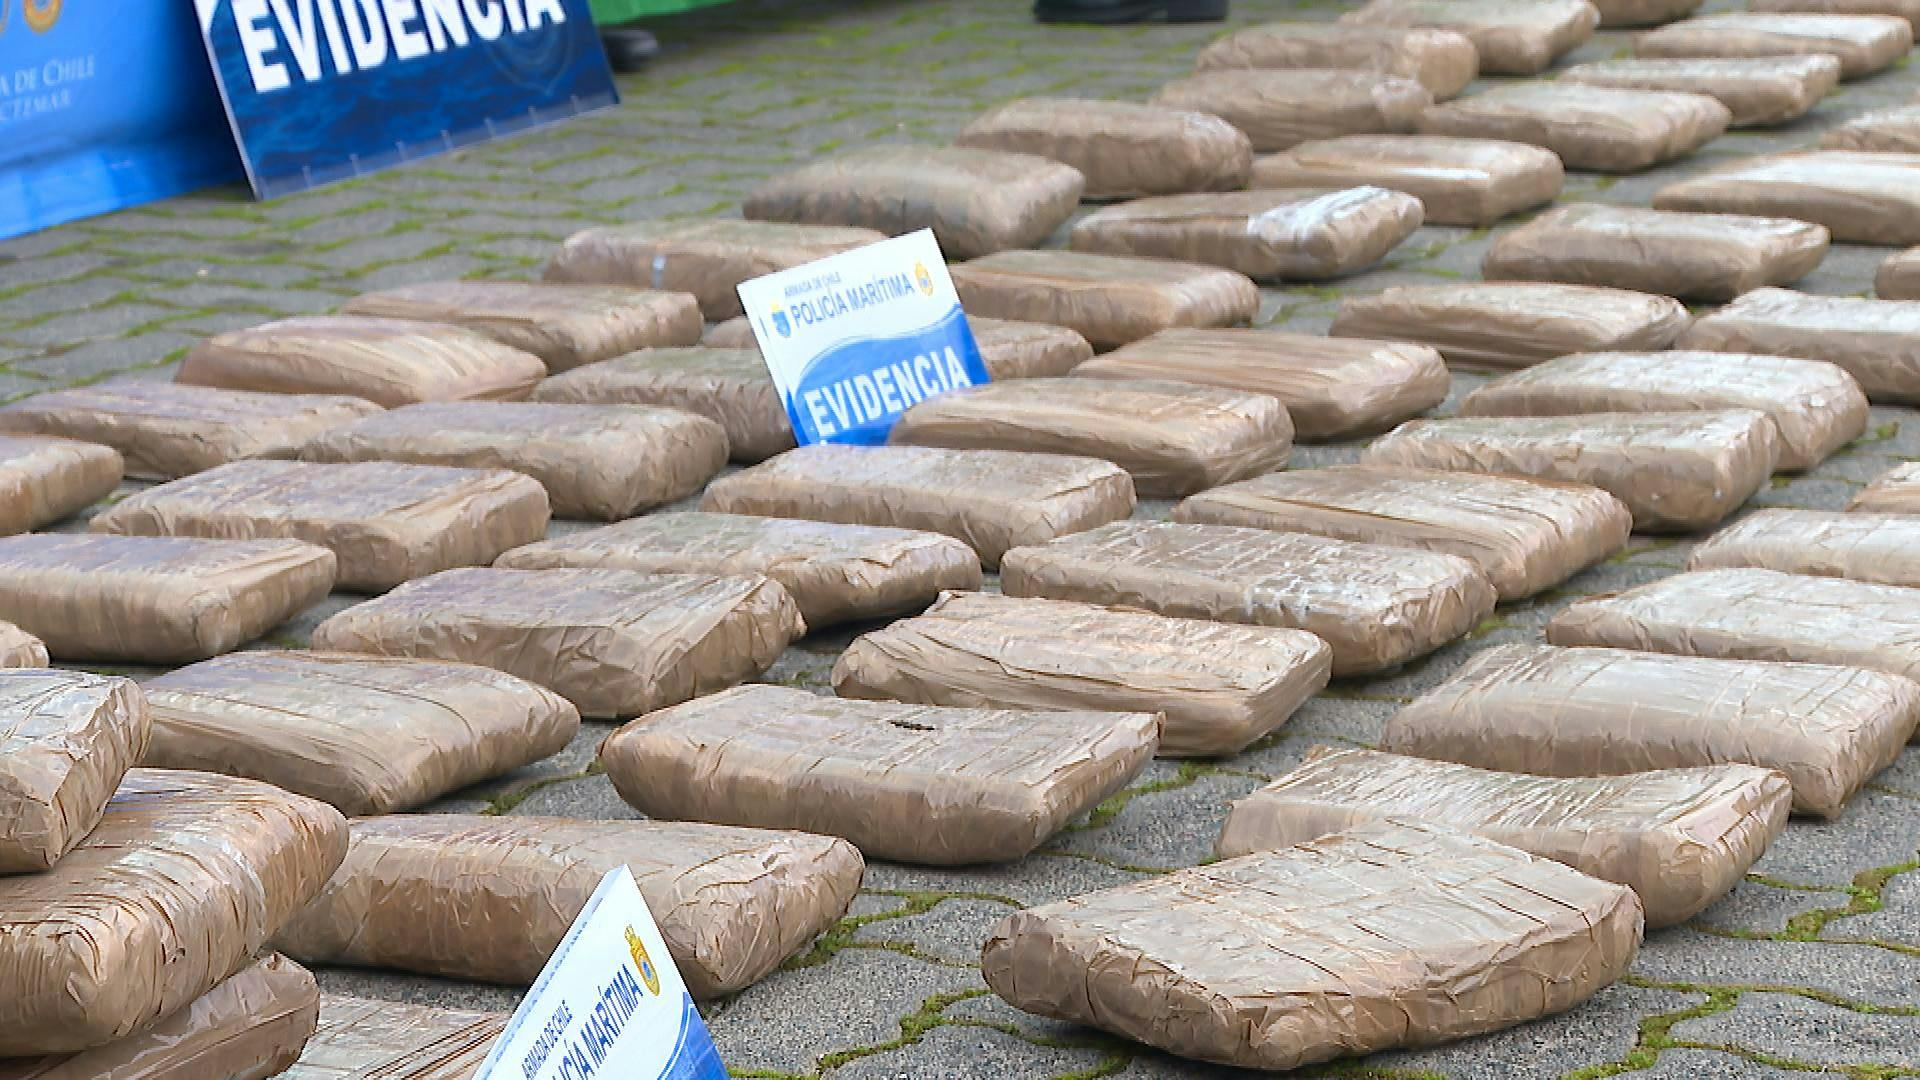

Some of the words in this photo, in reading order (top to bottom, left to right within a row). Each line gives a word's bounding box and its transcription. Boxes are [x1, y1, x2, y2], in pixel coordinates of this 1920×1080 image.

[791, 286, 848, 328] POLICÍA
[848, 272, 915, 311] MARÍTIMA
[804, 346, 972, 437] EVIDENCIA
[543, 1021, 558, 1048] DE
[552, 999, 573, 1035] CHILE
[580, 963, 643, 1068] MARÍTIMA
